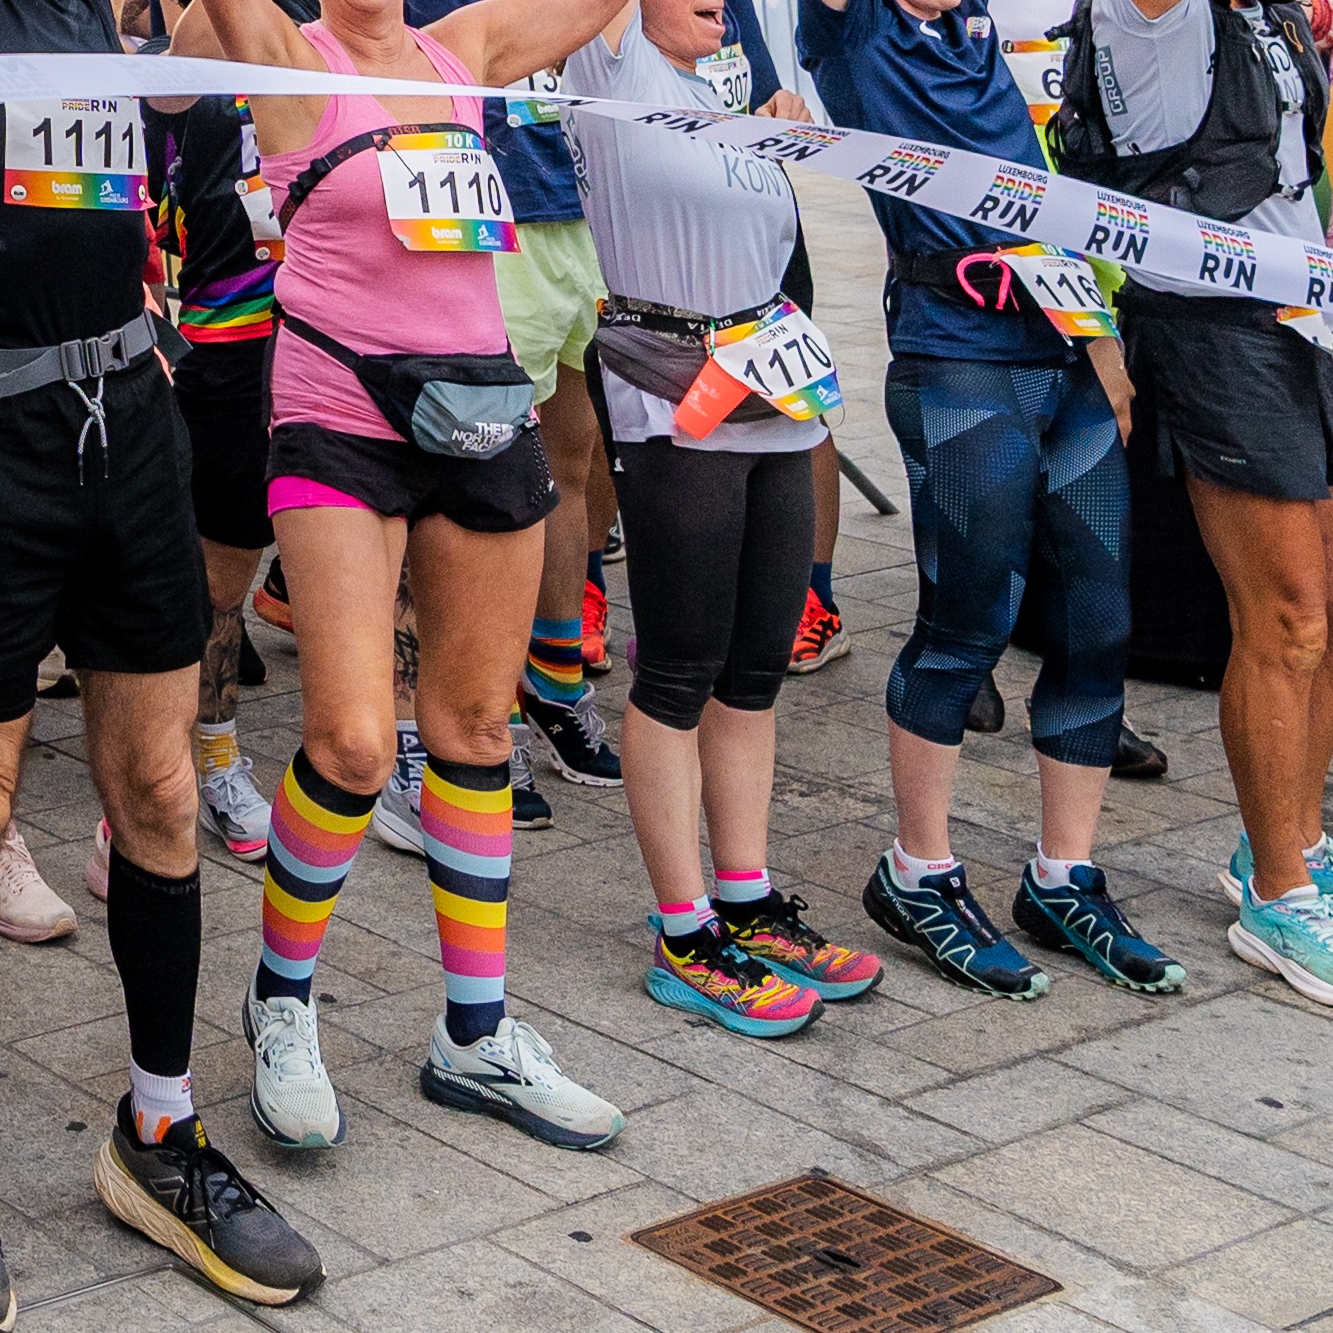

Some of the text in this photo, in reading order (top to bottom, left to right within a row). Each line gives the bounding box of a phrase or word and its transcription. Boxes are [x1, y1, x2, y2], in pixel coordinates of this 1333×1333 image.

[1097, 50, 1124, 114] GROUP
[32, 117, 133, 170] 1111
[445, 133, 474, 148] 10 K
[898, 142, 951, 160] LUXEMBOURG
[882, 150, 945, 176] PRIDE
[998, 163, 1048, 184] LUXEMBOURG
[408, 171, 502, 216] 1110
[855, 164, 931, 197] RUN
[987, 175, 1047, 206] PRIDE
[968, 194, 1040, 233] RUN
[1096, 190, 1148, 213] LUXEMBOURG
[1095, 202, 1150, 235] PRIDE
[1196, 219, 1251, 240] LUXEMBOURG
[1084, 223, 1150, 265] RUN
[1200, 230, 1257, 261] PRIDE
[1199, 251, 1257, 292] RUN
[1306, 255, 1333, 277] PRI
[1035, 273, 1106, 309] 116
[743, 333, 832, 396] 1170
[474, 421, 502, 435] THE
